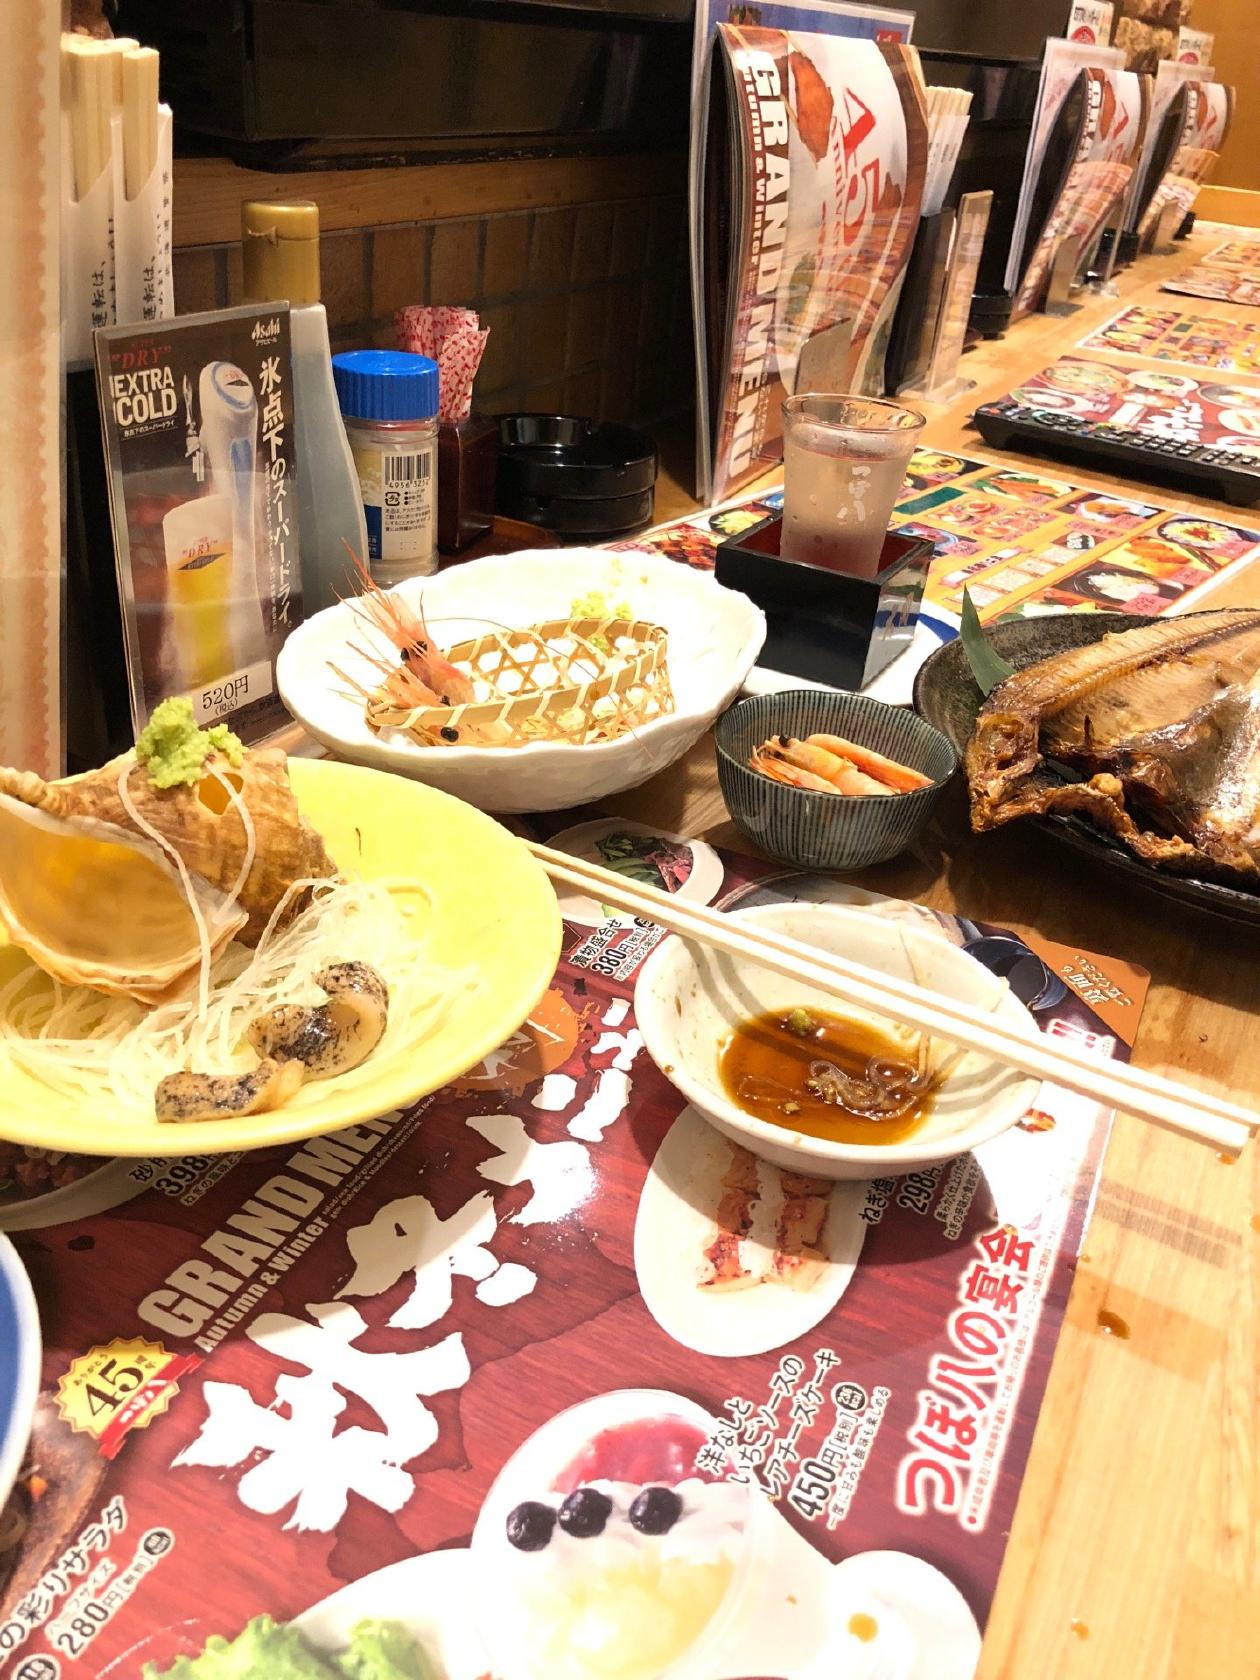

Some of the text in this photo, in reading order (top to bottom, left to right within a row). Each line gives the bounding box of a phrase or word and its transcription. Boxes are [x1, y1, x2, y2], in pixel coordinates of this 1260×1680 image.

[751, 50, 791, 296] GRAND
[755, 157, 765, 174] &
[251, 316, 281, 342] Asahi
[111, 366, 175, 399] EXTRA
[116, 388, 178, 427] COLD
[729, 301, 777, 479] MENU
[202, 674, 249, 709] 520円
[570, 918, 623, 969] 漬物盛合せ
[1061, 963, 1108, 1006] 裏面も
[1074, 955, 1133, 1008] ご覧ください
[137, 1097, 422, 1338] GRAND MEN
[194, 1216, 328, 1353] Autumn & Winter
[86, 1359, 145, 1416] 45
[904, 1224, 1034, 1509] つぼ八の宴会
[697, 1399, 752, 1474] 洋なしと
[731, 1356, 802, 1484] いちごソースの
[760, 1351, 840, 1498] レアチーズケーキ
[829, 1386, 891, 1528] 一度に甘みも酸味も楽しめる
[0, 1498, 125, 1660] の彩りサラダ
